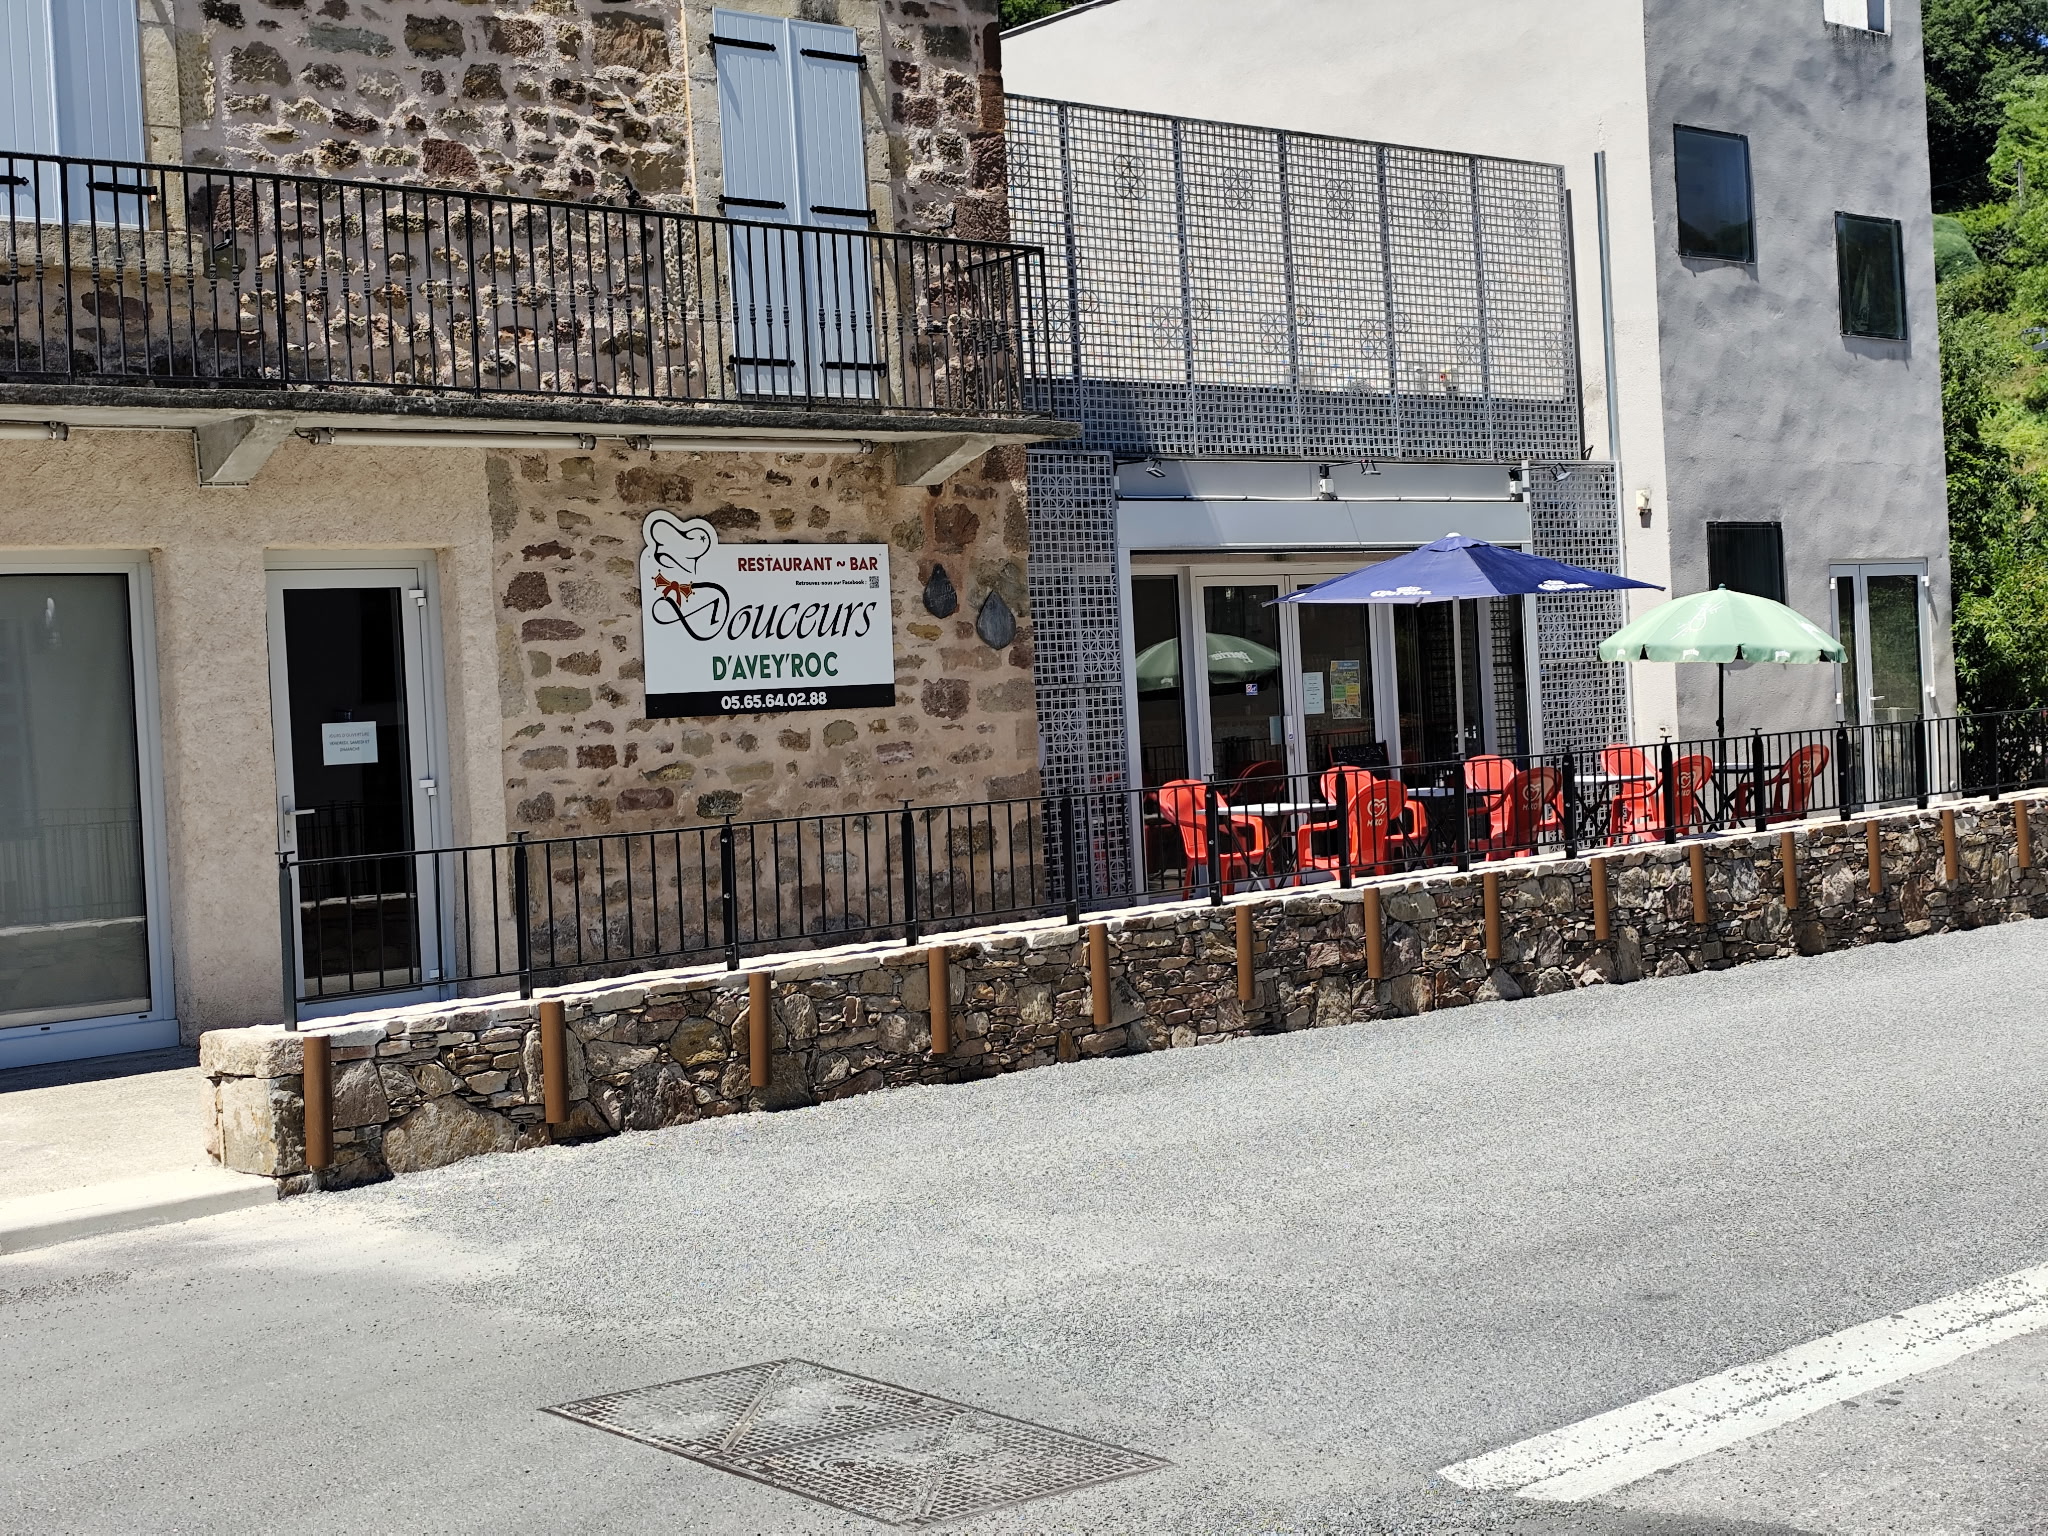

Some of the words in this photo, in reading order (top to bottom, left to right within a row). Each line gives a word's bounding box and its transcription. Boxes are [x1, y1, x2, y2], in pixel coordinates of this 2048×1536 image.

[737, 556, 833, 572] RESTAURANT
[849, 555, 879, 571] BAR
[652, 581, 877, 641] Douceurs
[712, 651, 839, 681] D'AVEY'ROC
[720, 691, 828, 711] 05.65.64.02.88
